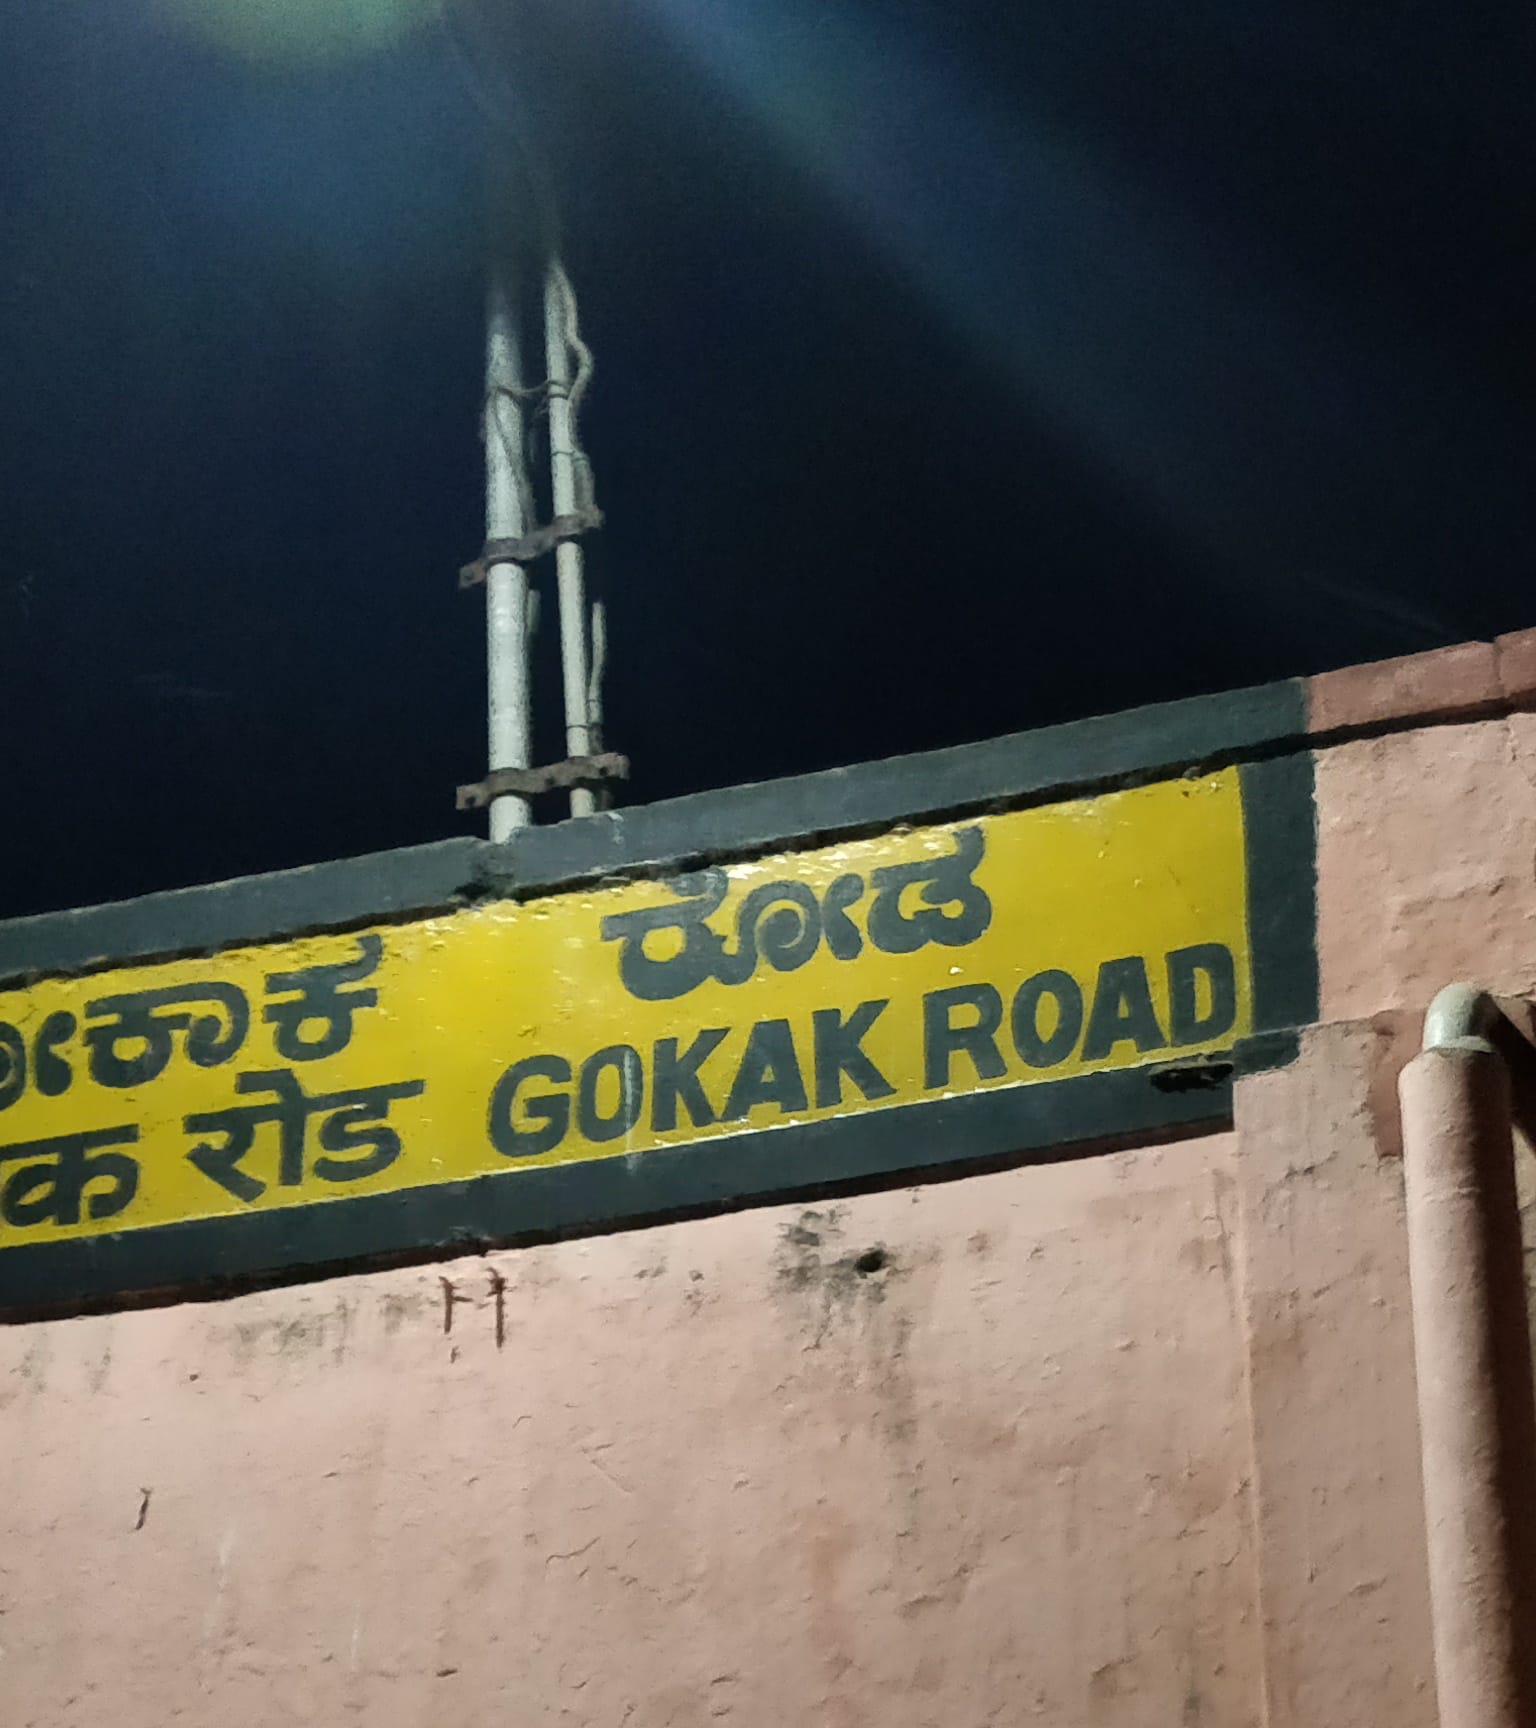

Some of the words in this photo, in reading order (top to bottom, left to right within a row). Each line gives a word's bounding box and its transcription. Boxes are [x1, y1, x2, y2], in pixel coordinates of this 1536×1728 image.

[184, 1068, 425, 1203] रोड
[487, 999, 898, 1158] GOKAK
[923, 943, 1238, 1091] ROAD
